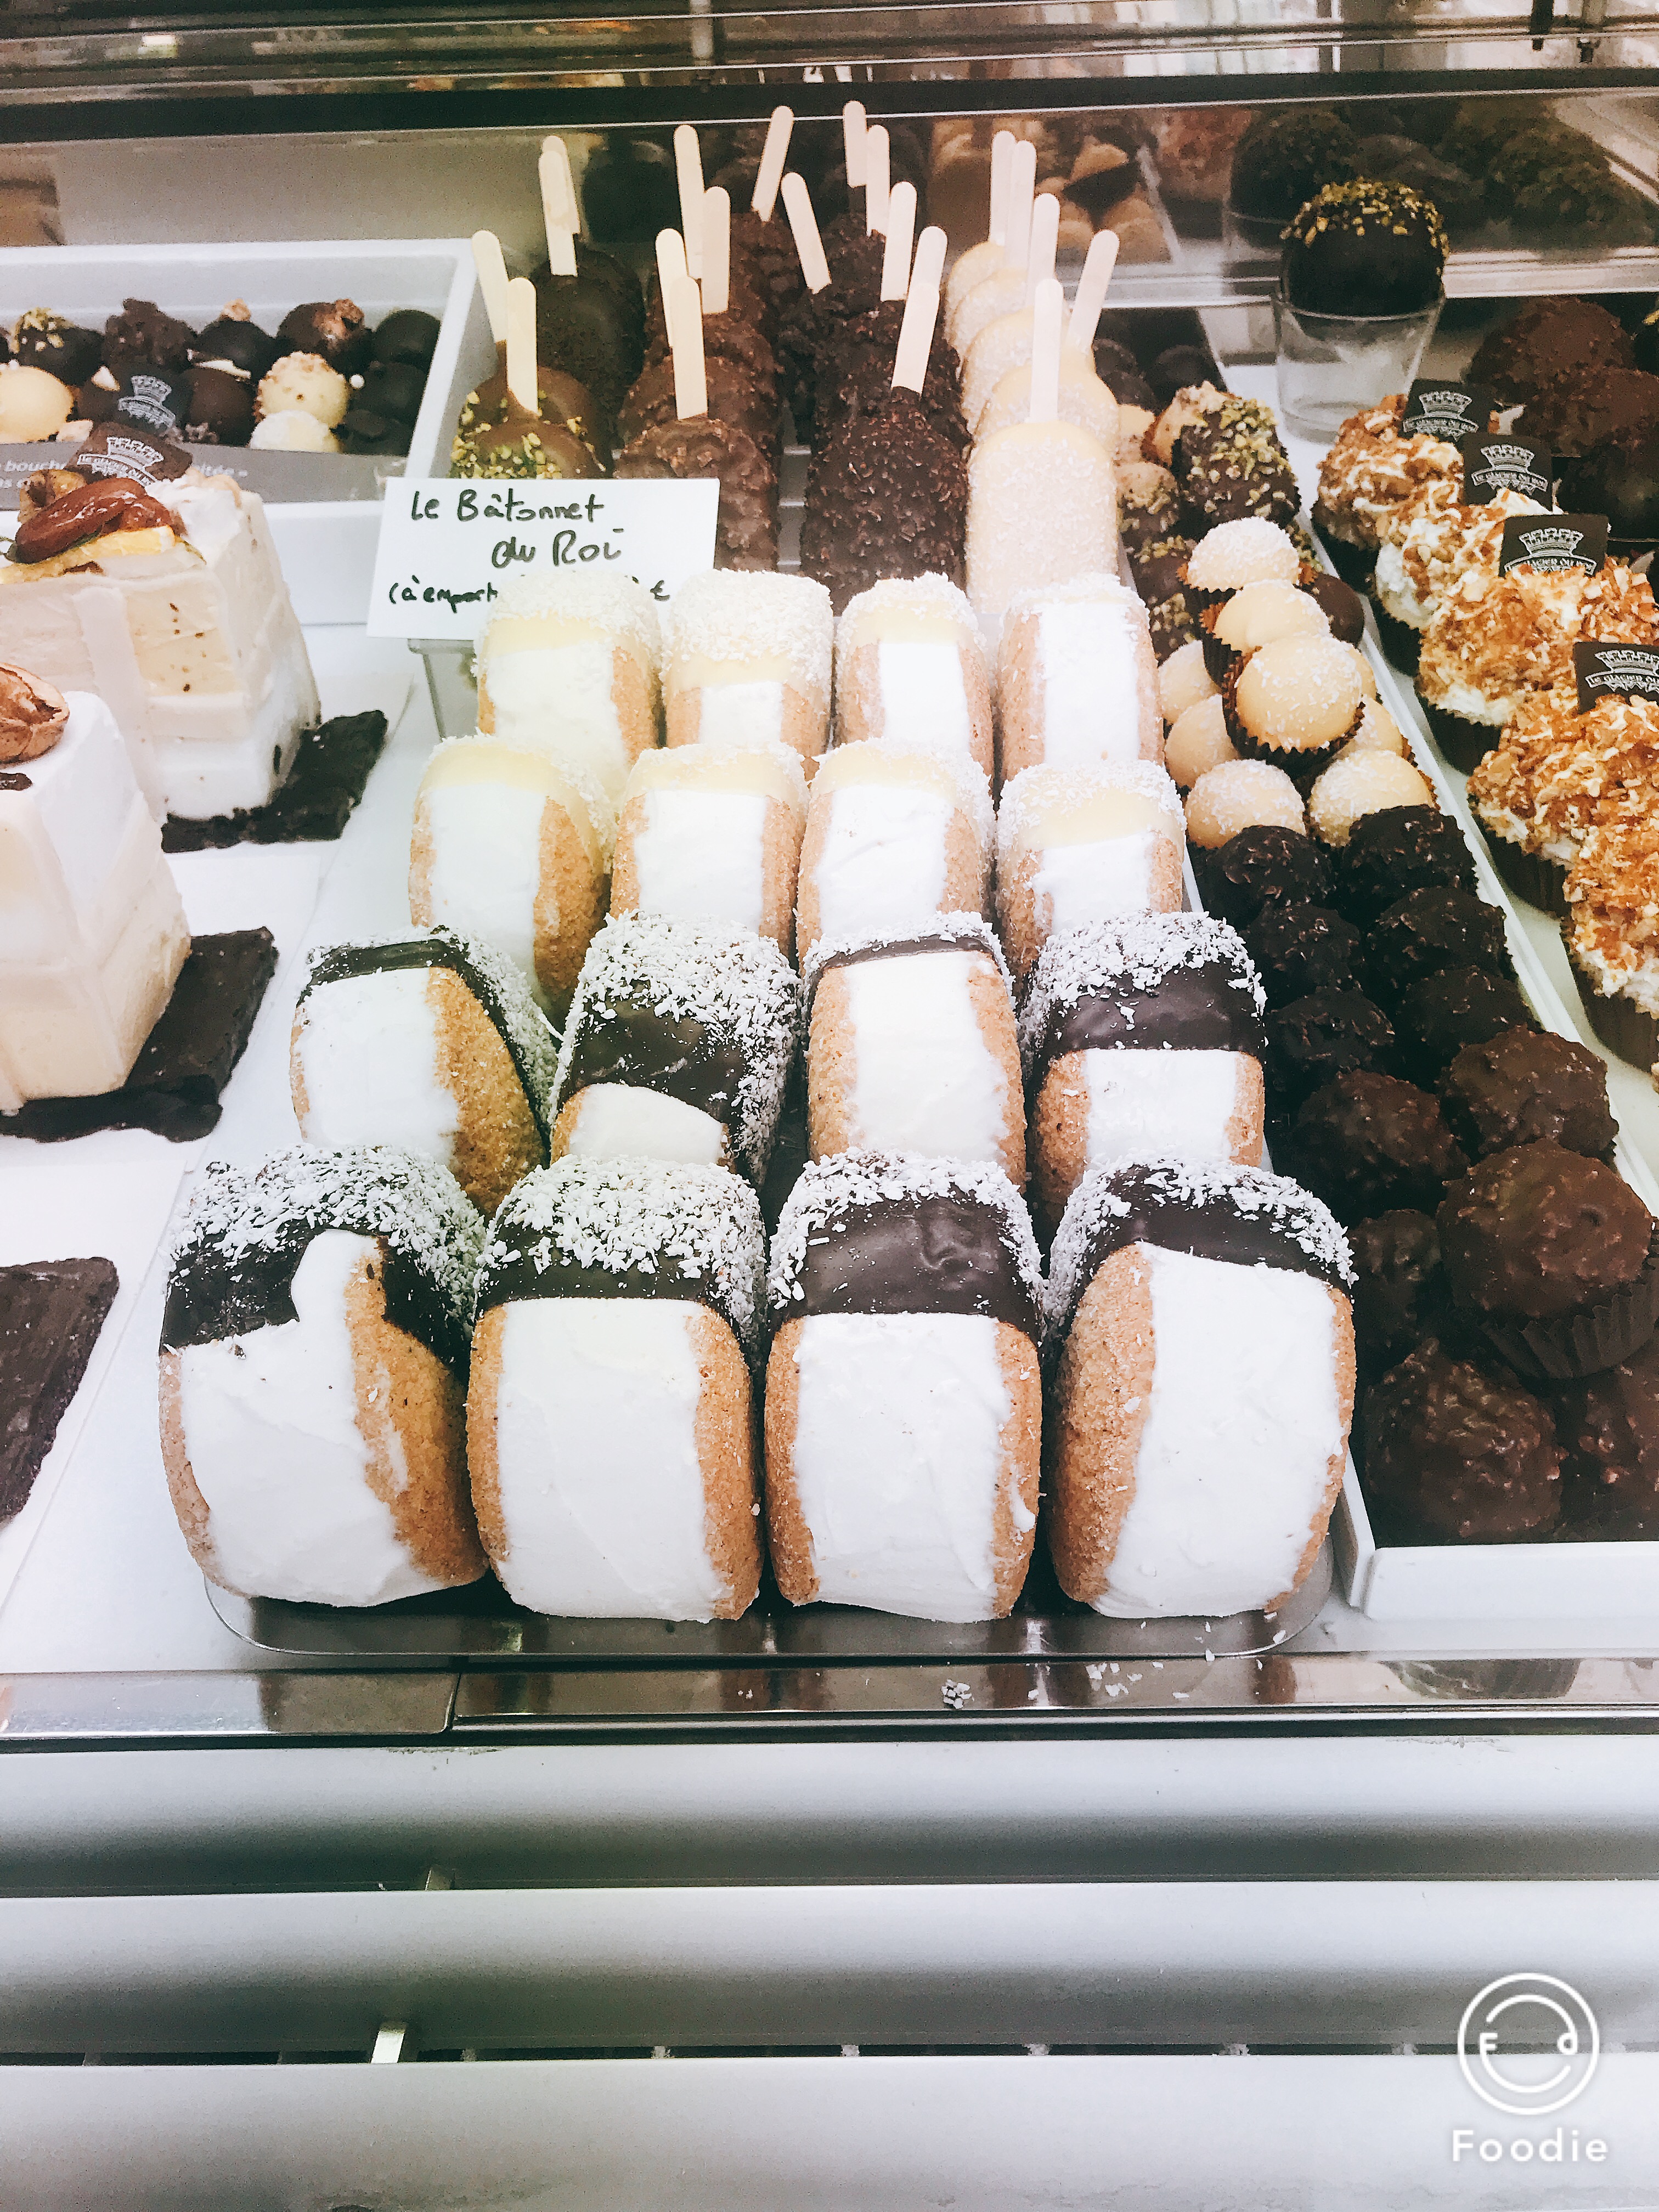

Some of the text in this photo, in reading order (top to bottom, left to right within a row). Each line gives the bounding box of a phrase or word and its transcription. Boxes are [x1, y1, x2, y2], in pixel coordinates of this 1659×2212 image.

[411, 488, 605, 523] Le Bâtonnet
[492, 528, 624, 569] du Roi
